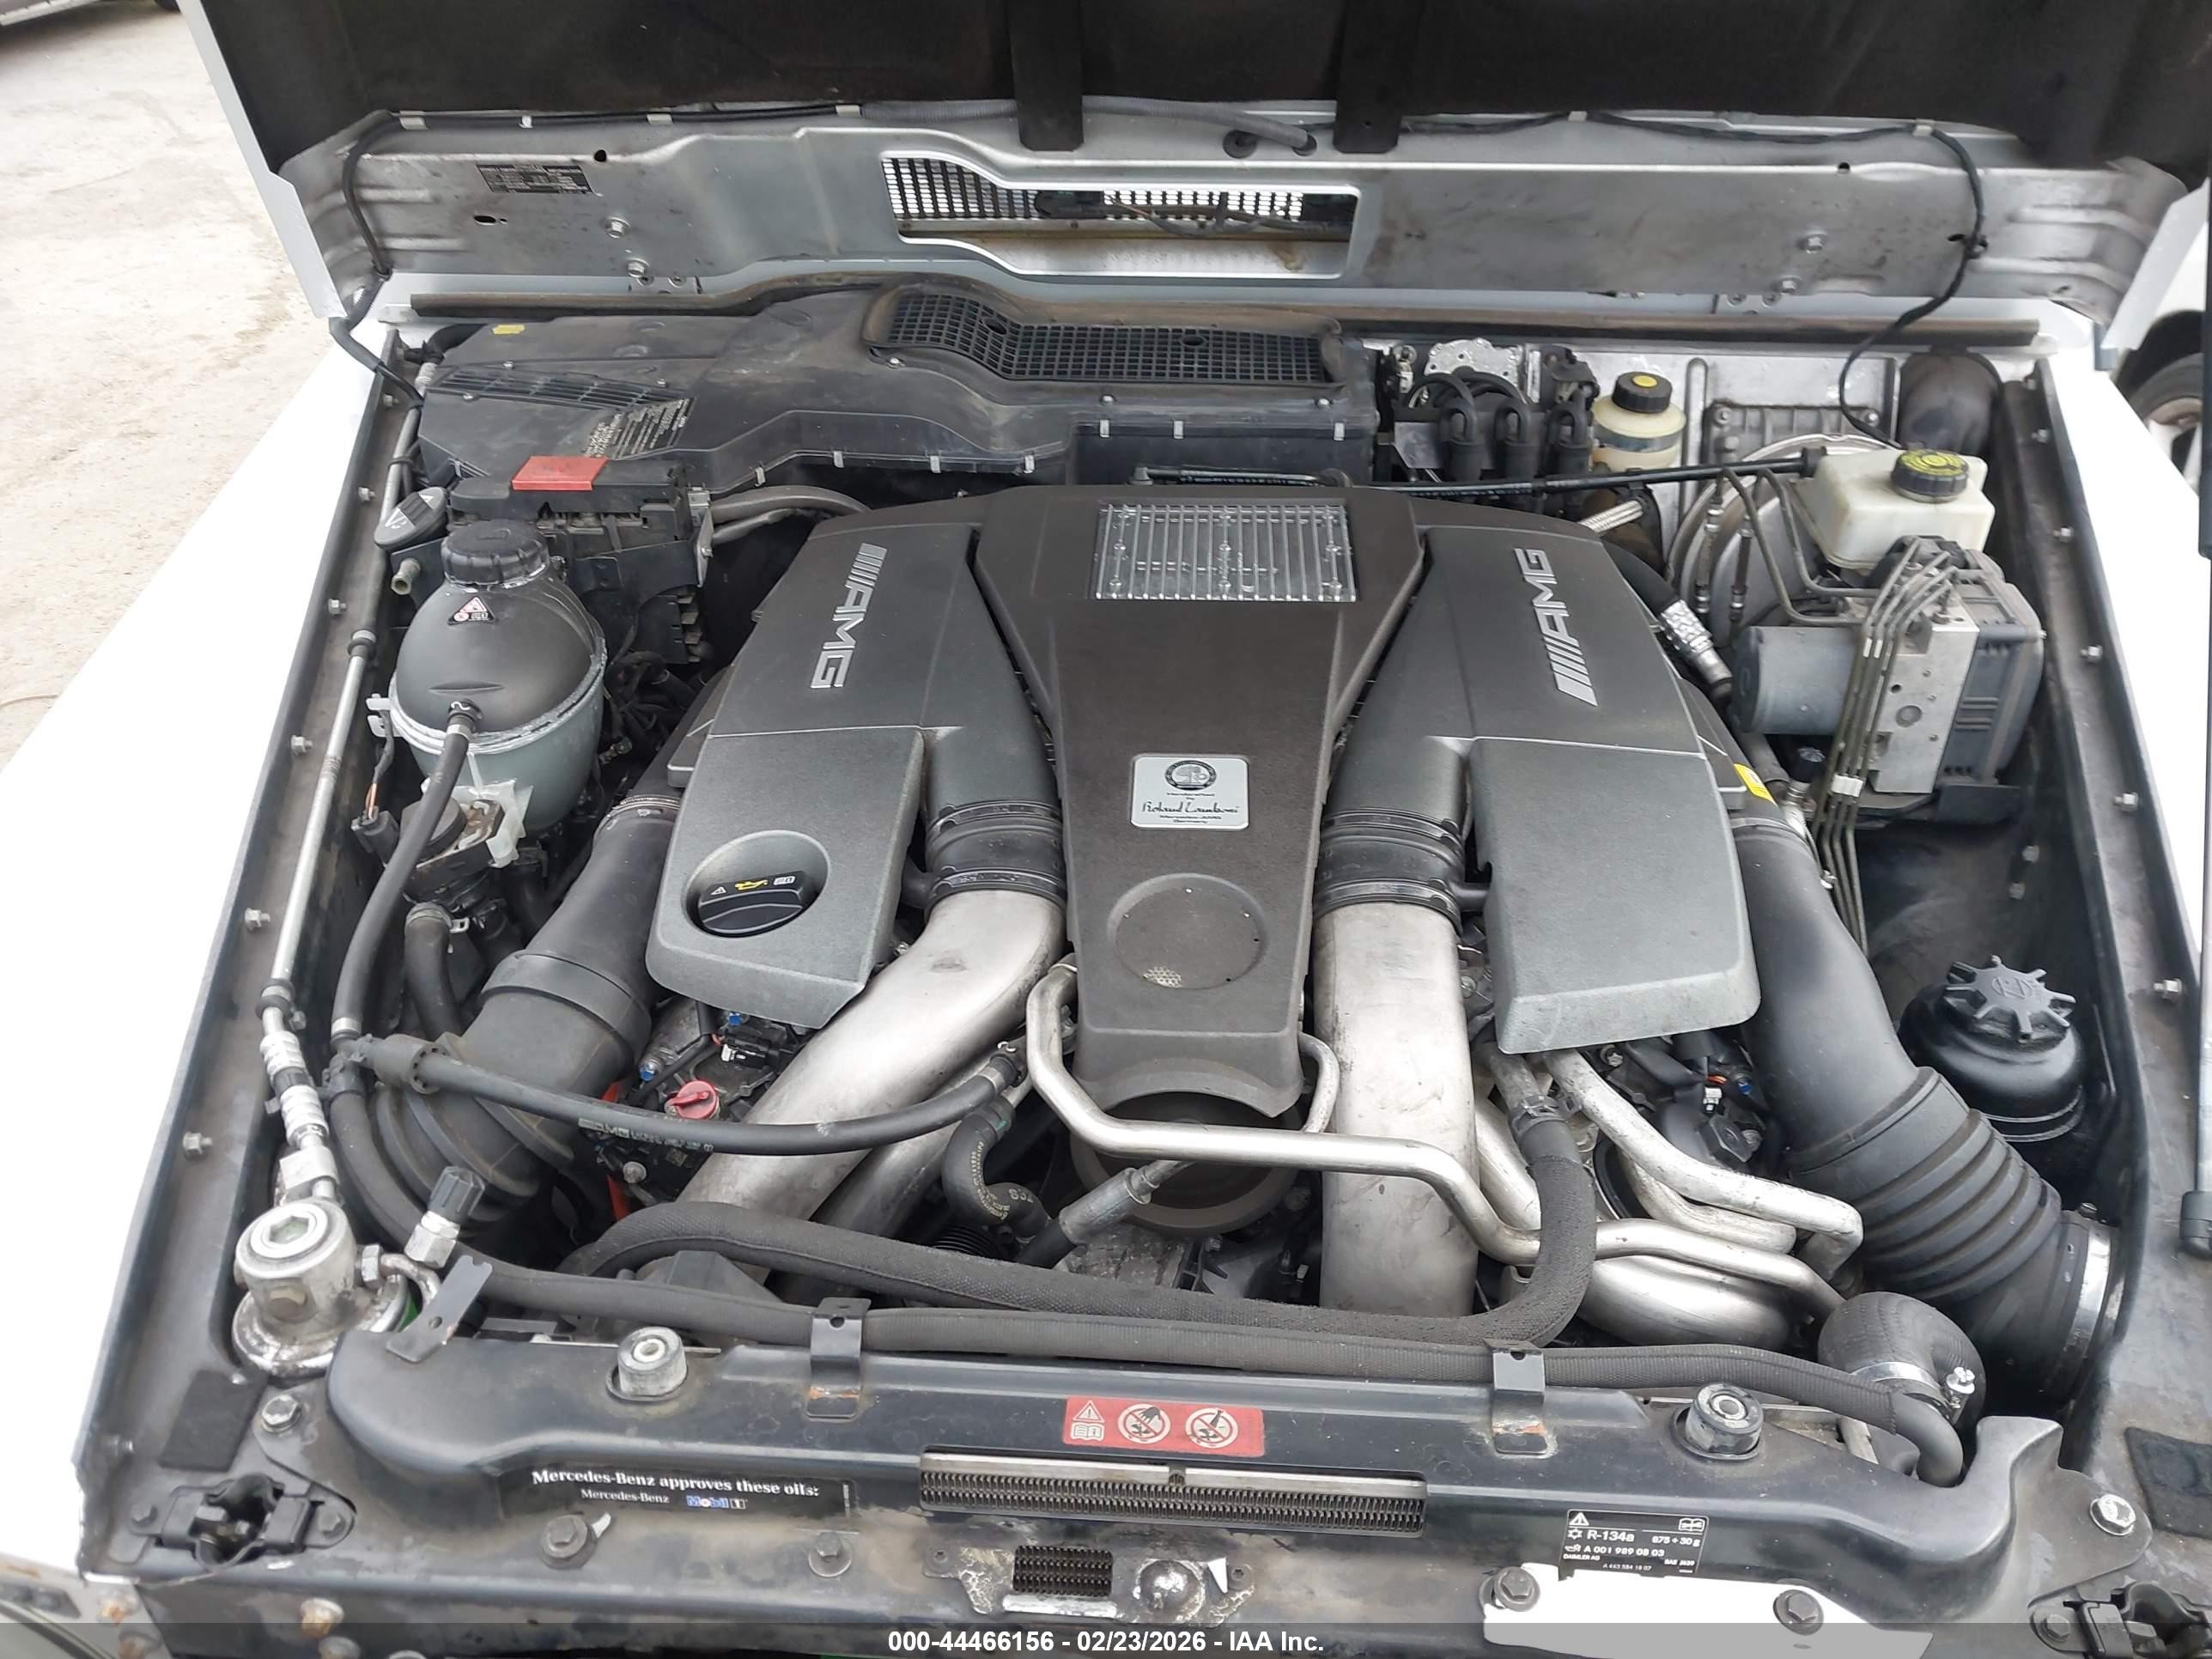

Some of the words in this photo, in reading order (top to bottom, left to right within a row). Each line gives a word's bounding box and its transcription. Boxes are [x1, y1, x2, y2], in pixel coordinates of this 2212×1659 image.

[532, 1469, 655, 1487] Mercedes-Benz
[659, 1477, 732, 1492] approves
[735, 1480, 781, 1495] these
[784, 1482, 819, 1497] oils:
[580, 1489, 670, 1504] Mercedes-Benz
[686, 1495, 729, 1510] Mobil
[1587, 1529, 1635, 1542] R-134a
